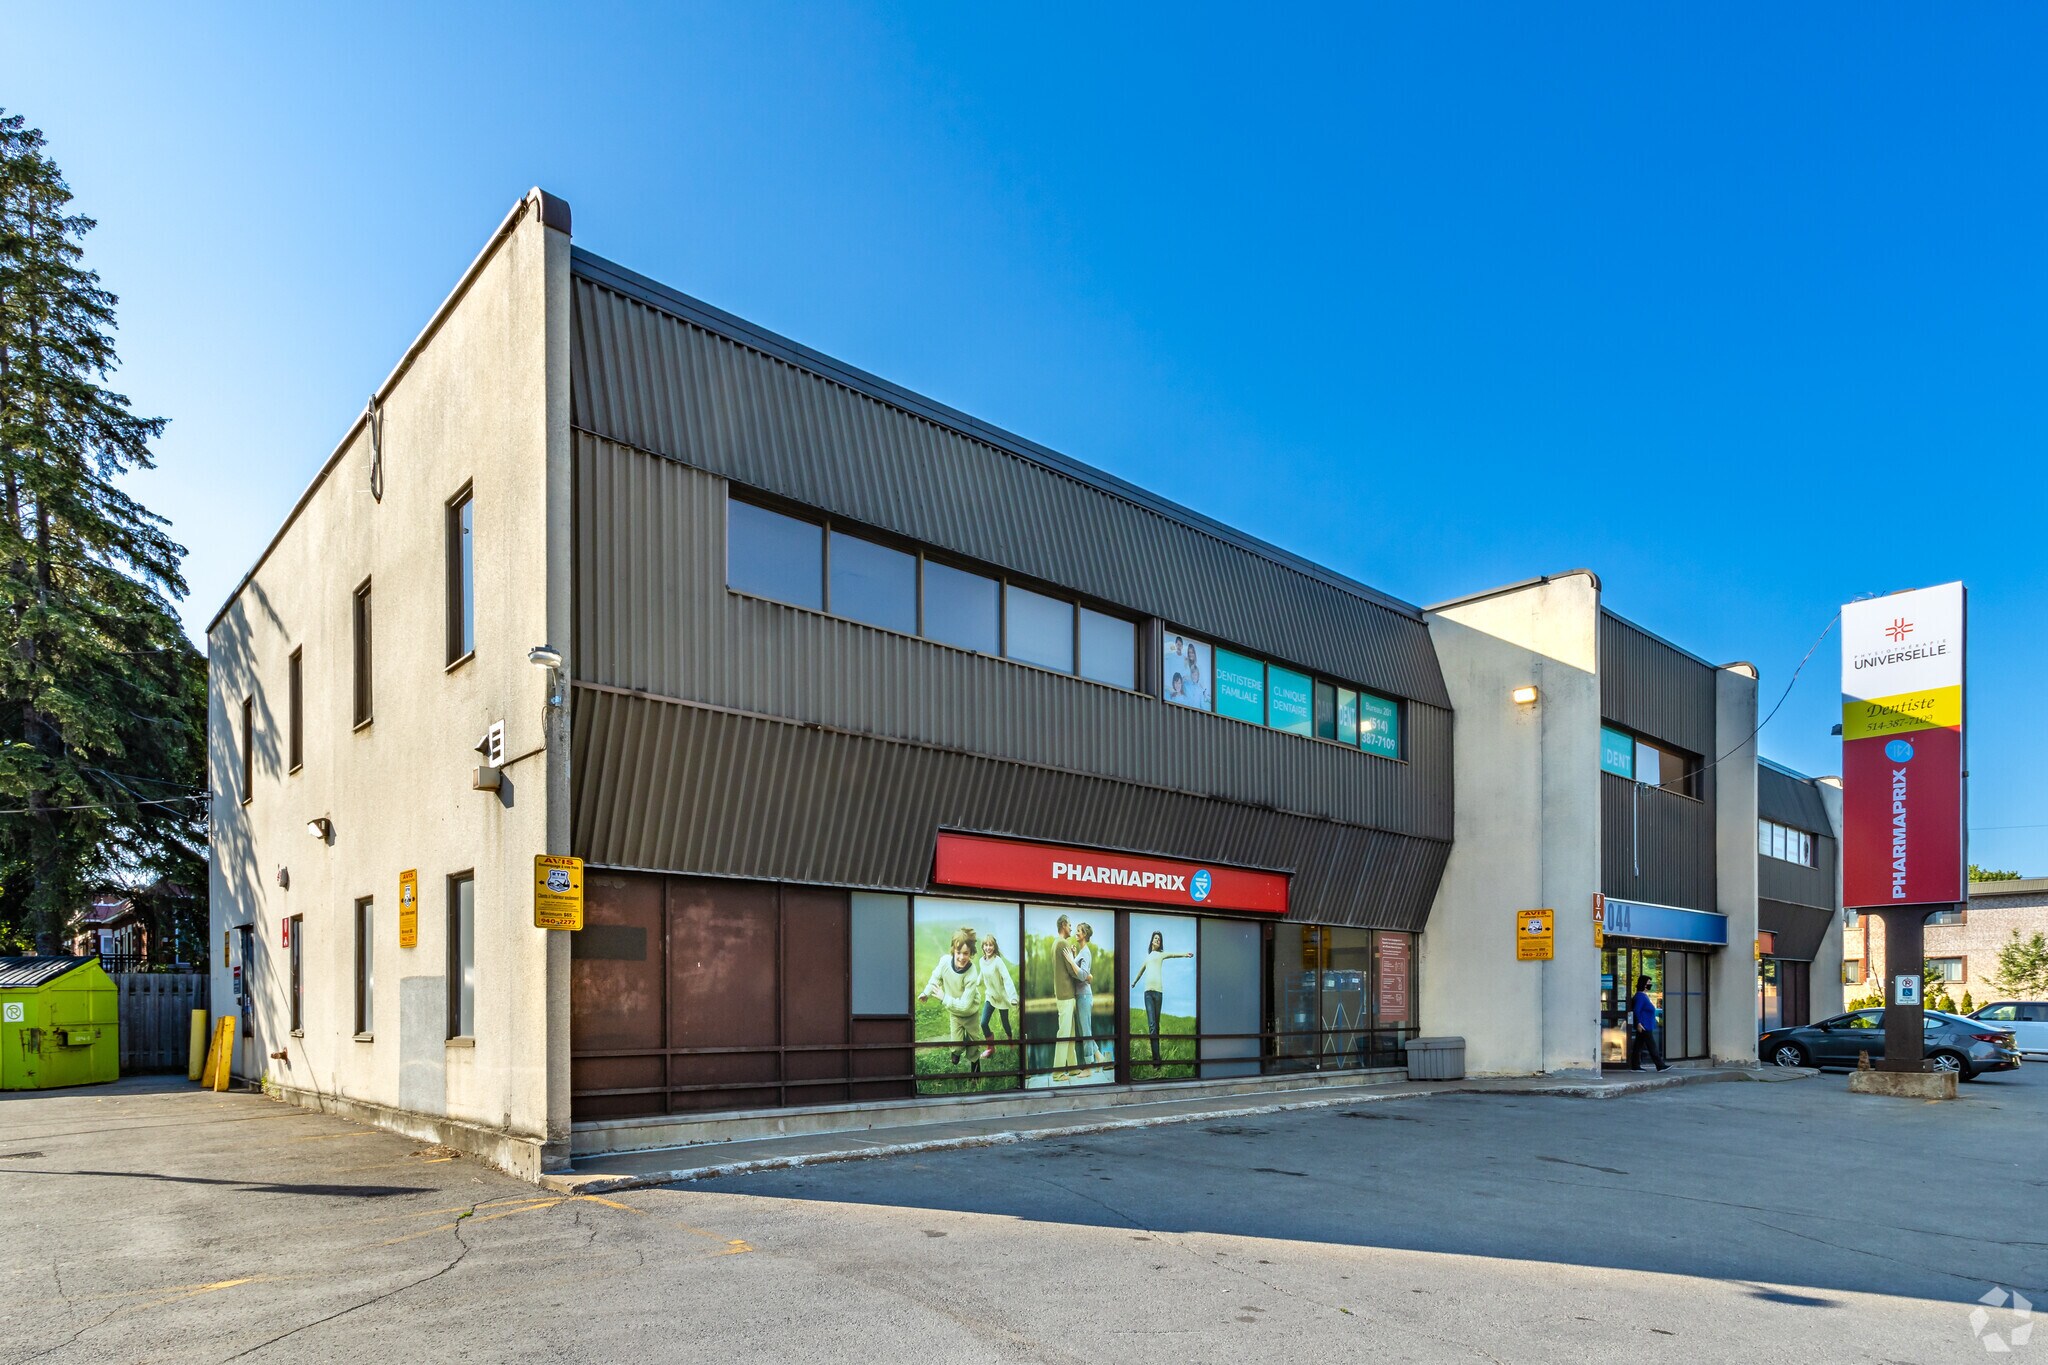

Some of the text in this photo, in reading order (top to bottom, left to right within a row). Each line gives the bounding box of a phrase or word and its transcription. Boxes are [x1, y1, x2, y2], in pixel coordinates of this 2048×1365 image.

[1854, 644, 1947, 670] UNIVERSELLE
[1216, 668, 1263, 691] DENTISTERIE
[1221, 684, 1258, 704] FAMILIALE
[1273, 686, 1307, 704] CLINIQUE
[1273, 699, 1308, 717] DENTAIRE
[1365, 701, 1393, 717] Bureau 201
[1867, 698, 1936, 718] Dentiste
[1369, 716, 1389, 734] (514)
[1866, 714, 1934, 732] 514-387-7109
[1361, 732, 1396, 751] 387-7109
[1606, 748, 1631, 771] DENT
[1892, 767, 1907, 899] PHARMAPRIX
[544, 857, 574, 865] AVIS
[1052, 861, 1186, 892] PHARMAPRIX
[1603, 903, 1631, 932] 044
